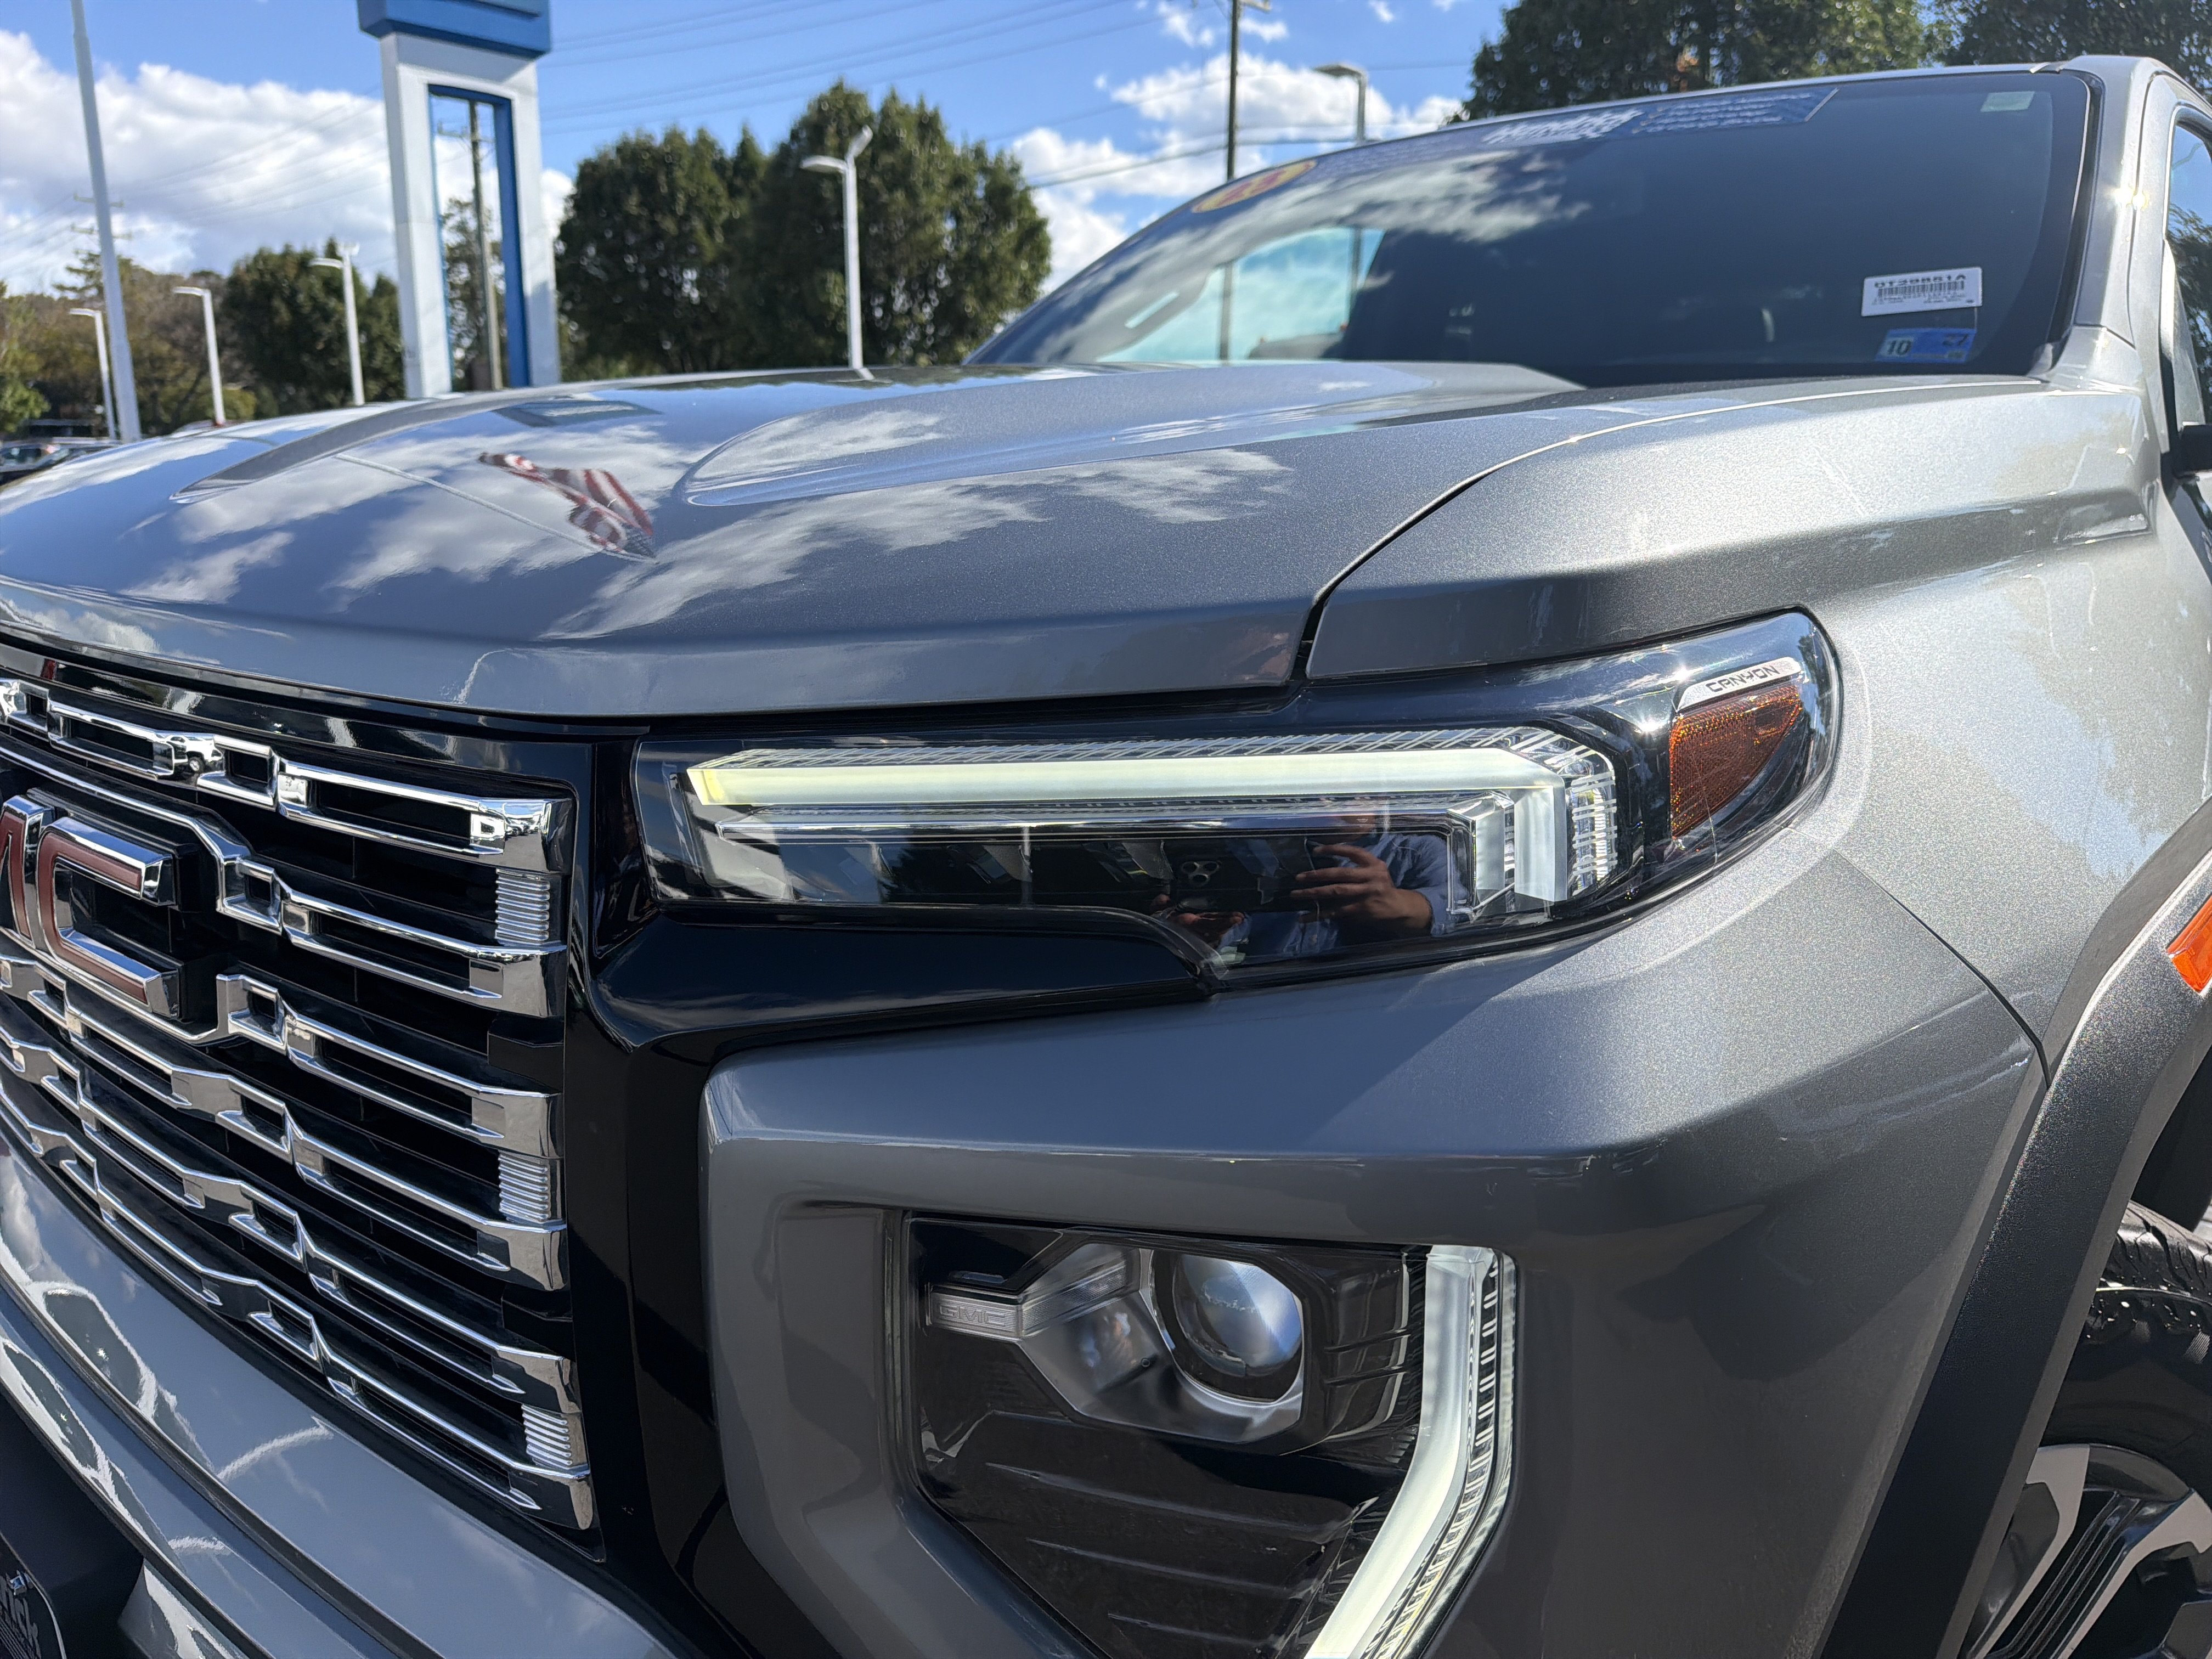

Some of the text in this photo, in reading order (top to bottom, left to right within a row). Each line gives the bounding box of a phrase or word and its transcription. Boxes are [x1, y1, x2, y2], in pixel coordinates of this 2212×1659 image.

[1887, 340, 1911, 356] 10
[1705, 665, 1780, 692] CANYON
[939, 1305, 1006, 1327] GMC
